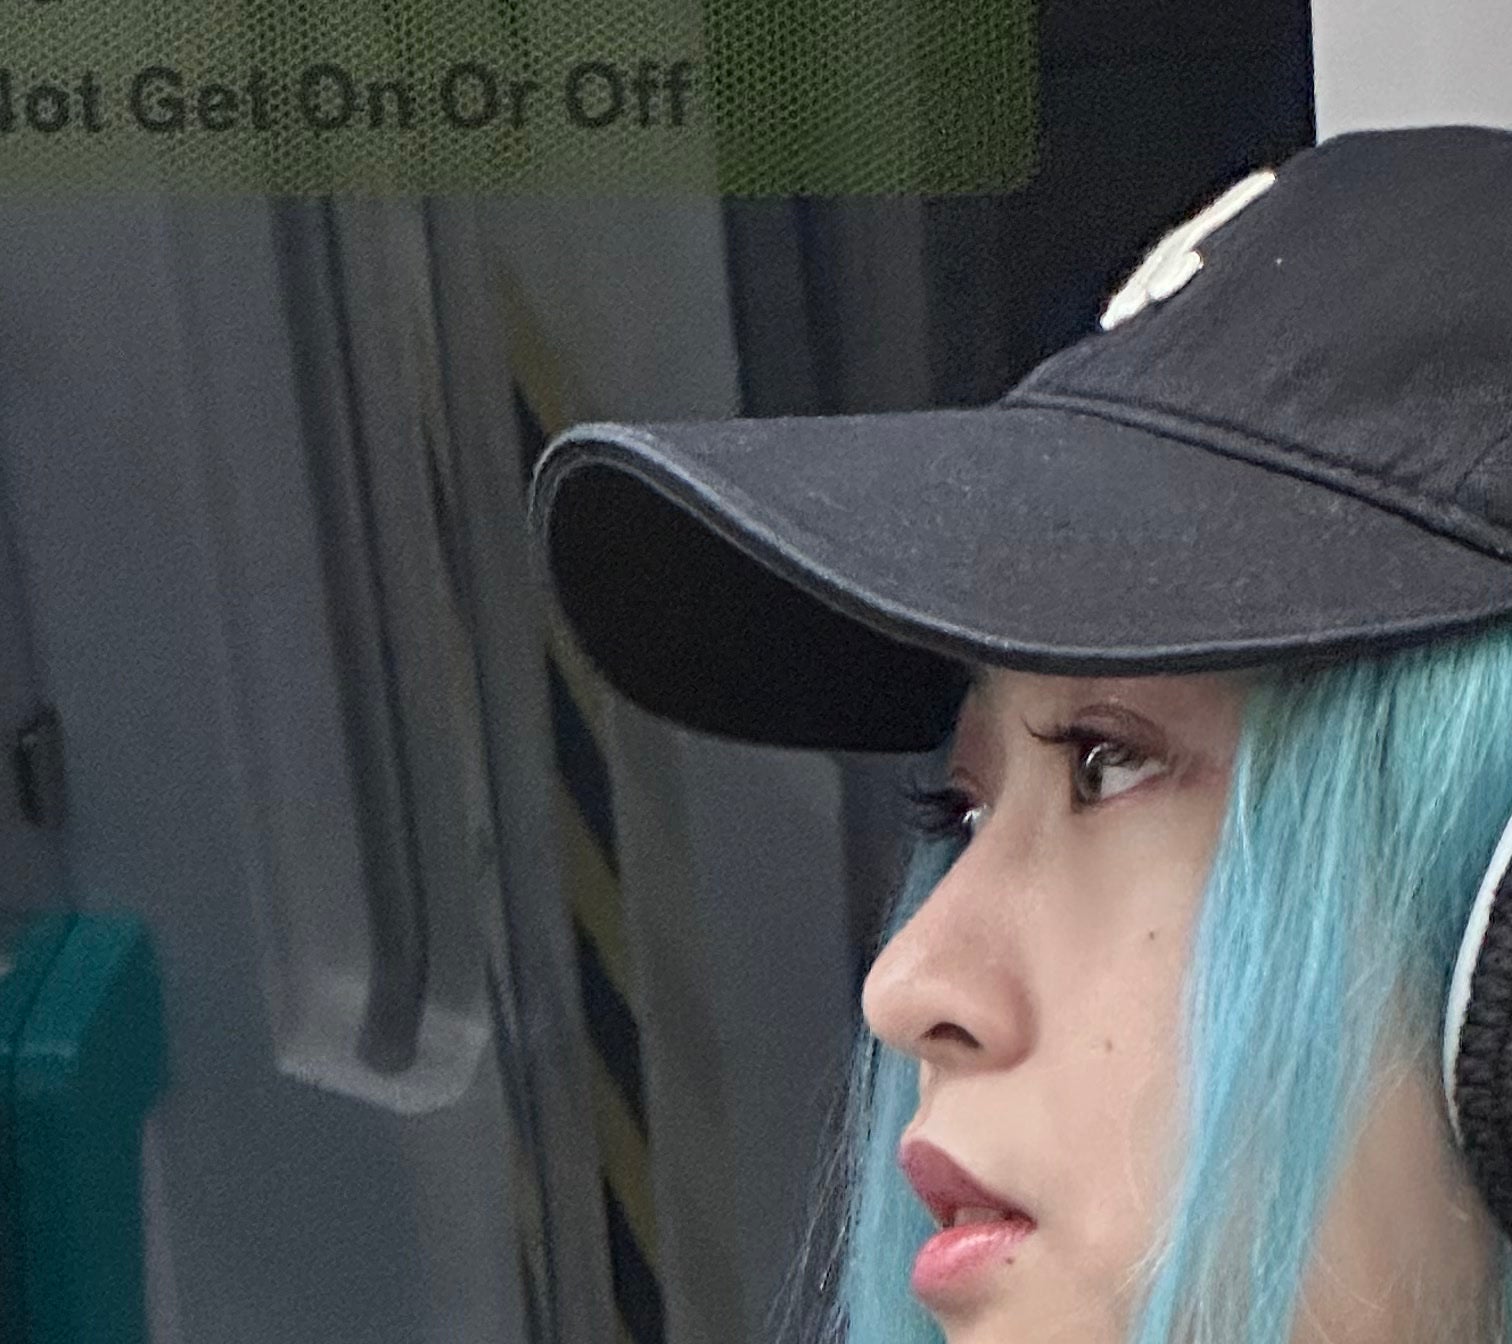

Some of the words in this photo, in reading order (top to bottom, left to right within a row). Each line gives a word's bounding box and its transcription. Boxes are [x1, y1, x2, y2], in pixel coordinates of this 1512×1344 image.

[0, 66, 103, 133] ot
[129, 64, 273, 133] Get
[298, 63, 415, 132] On
[439, 60, 540, 131] Or
[564, 59, 691, 130] Off
